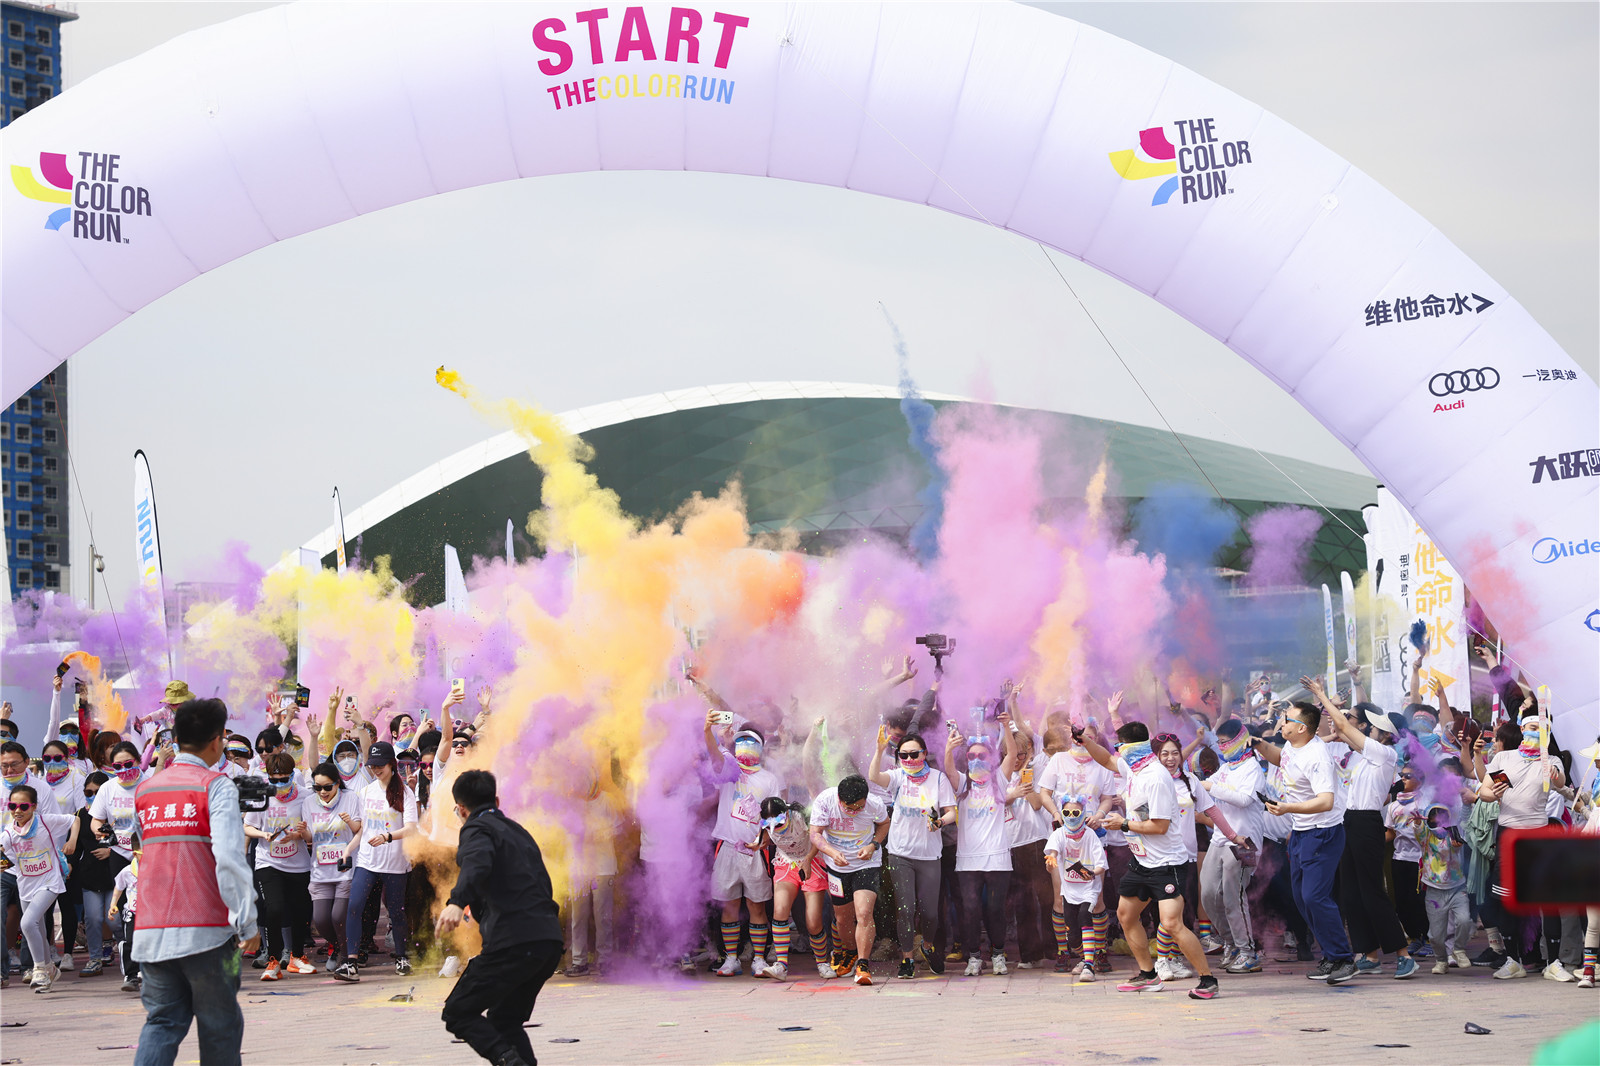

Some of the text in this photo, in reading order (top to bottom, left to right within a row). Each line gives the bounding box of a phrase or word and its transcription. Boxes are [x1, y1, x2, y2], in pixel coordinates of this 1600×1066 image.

[532, 6, 750, 76] START
[1174, 118, 1219, 146] THE
[78, 151, 121, 183] THE
[1178, 140, 1253, 175] COLOR
[74, 181, 152, 217] COLOR
[1181, 170, 1227, 204] RUN
[73, 210, 122, 243] RUN
[1365, 293, 1473, 327] 维他命水
[1522, 369, 1578, 382] 一汽奥迪
[1433, 399, 1465, 413] Audi
[152, 821, 199, 829] PHOTOGRAPHY
[24, 860, 47, 873] 30648
[322, 850, 343, 860] 21841
